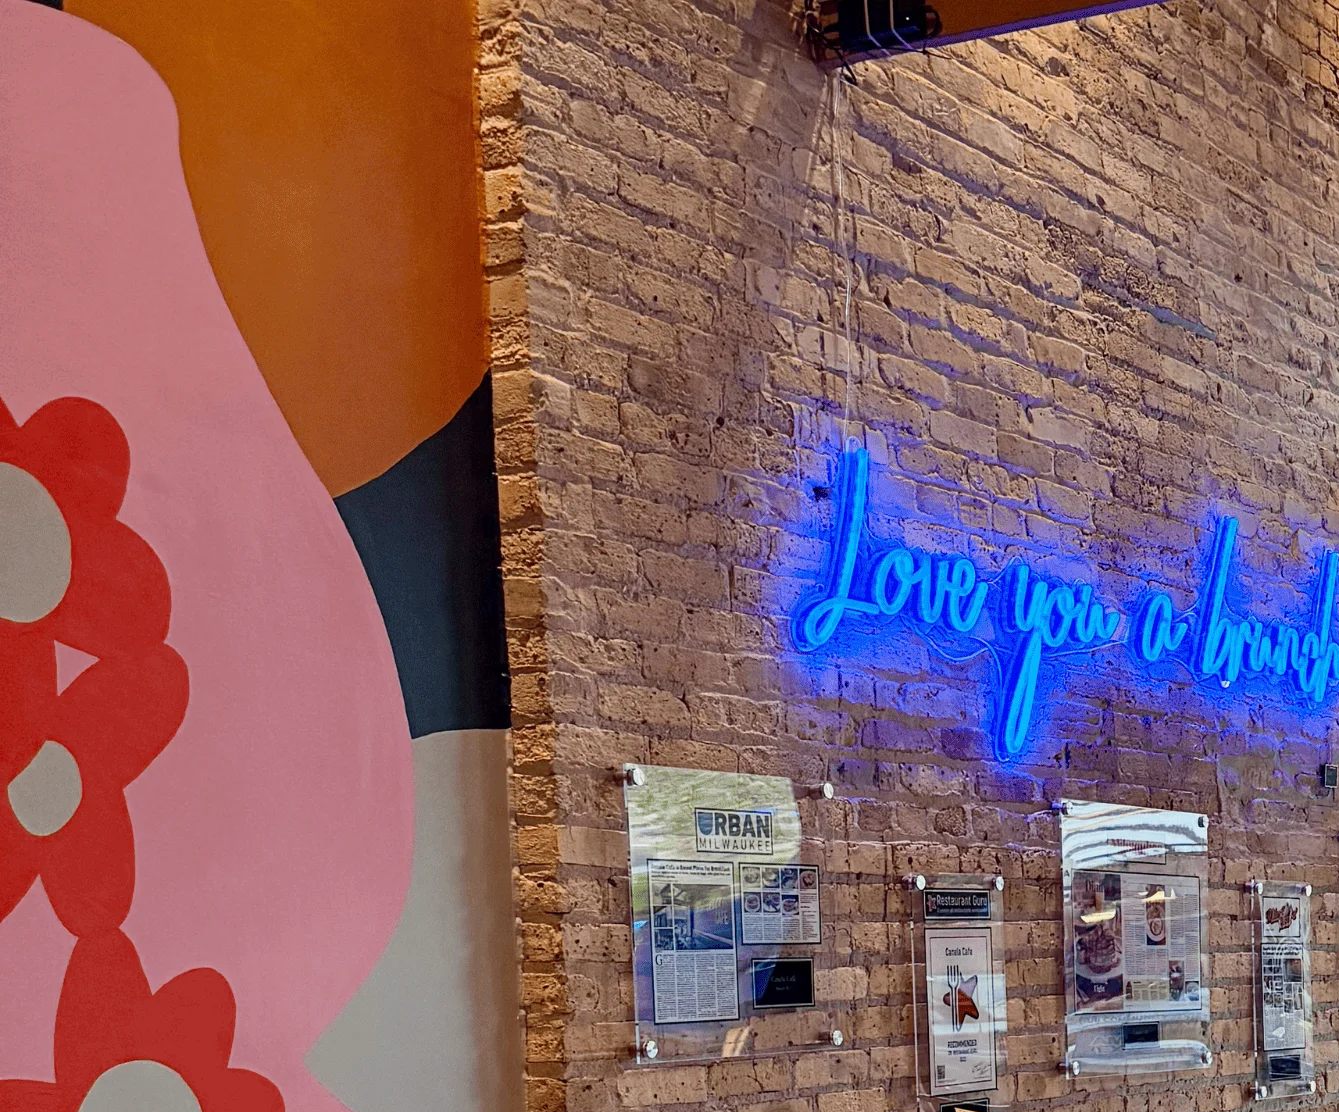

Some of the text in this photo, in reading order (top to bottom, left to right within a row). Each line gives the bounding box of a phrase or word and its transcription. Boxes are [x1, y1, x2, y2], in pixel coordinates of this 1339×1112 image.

[800, 447, 989, 649] Love
[1003, 562, 1121, 755] you
[1139, 591, 1190, 662] a
[697, 811, 770, 838] URBAN
[699, 838, 771, 852] MILWAUKEE
